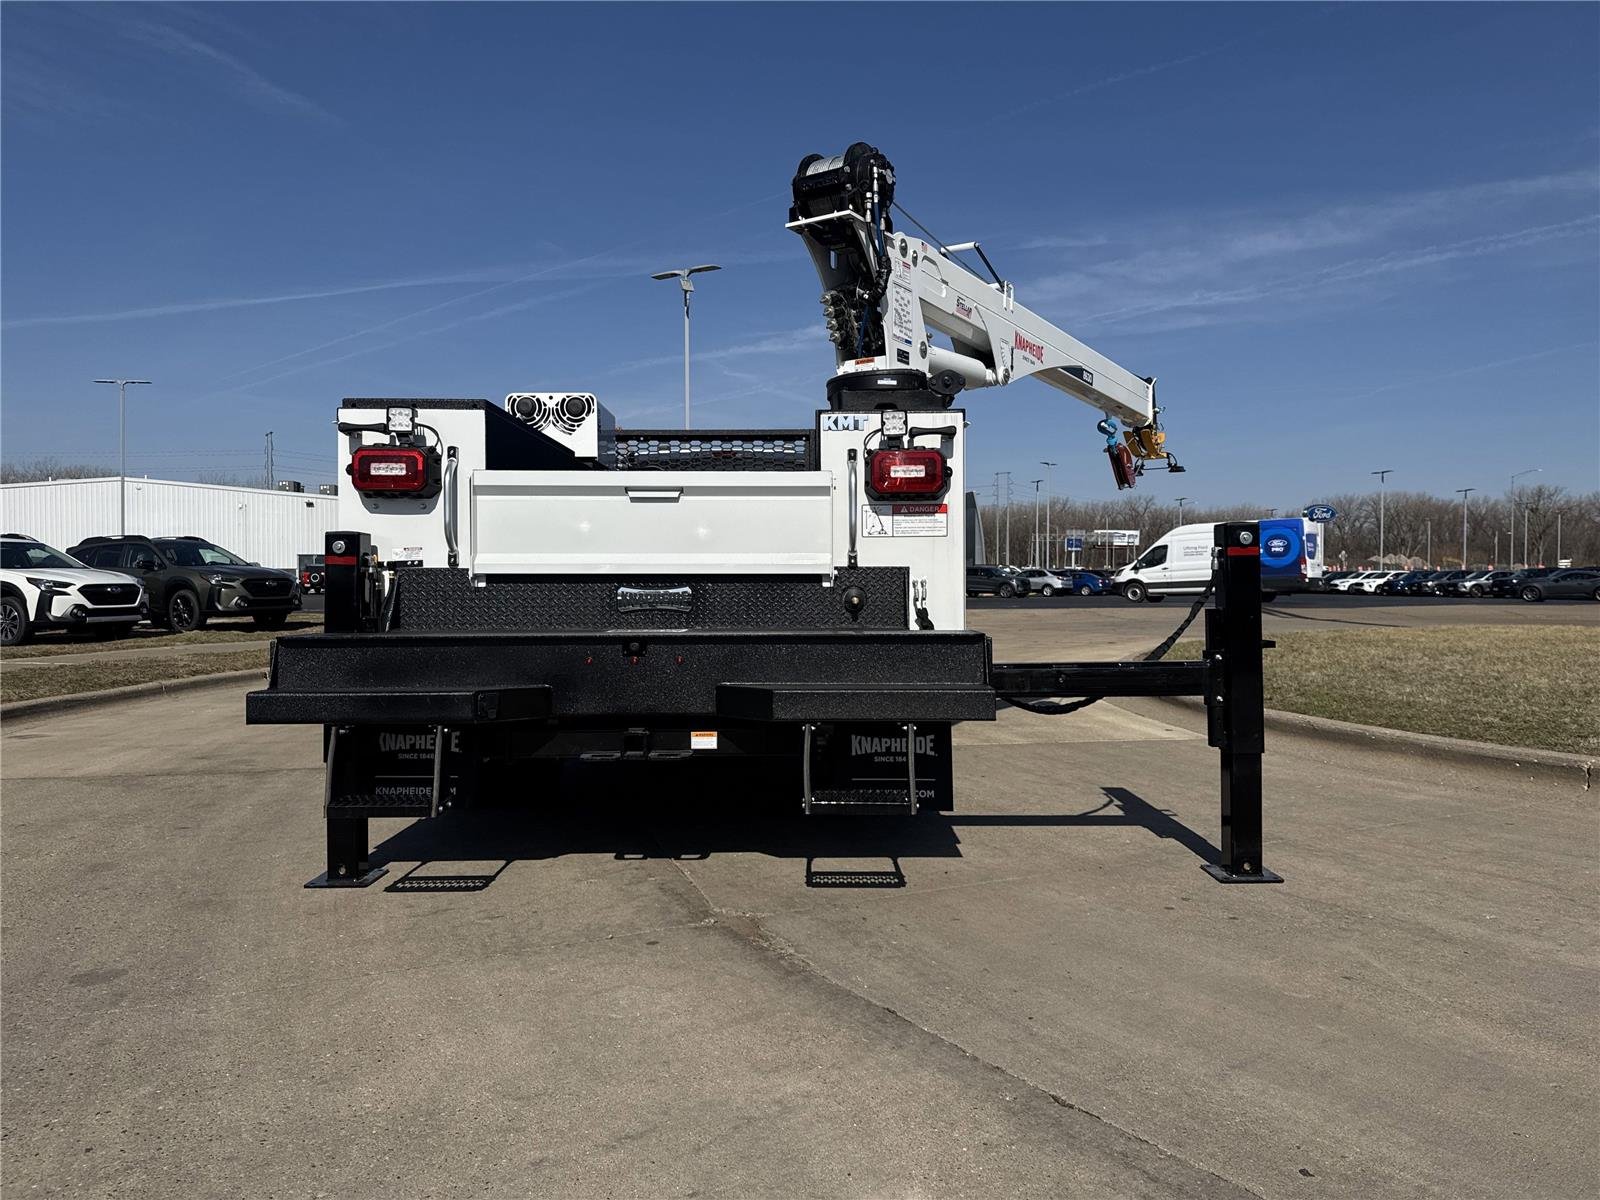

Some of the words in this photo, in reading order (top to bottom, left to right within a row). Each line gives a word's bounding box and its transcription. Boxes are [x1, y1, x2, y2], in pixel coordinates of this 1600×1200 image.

[1014, 330, 1044, 364] KNAPHEIDE
[822, 414, 868, 431] KMT
[909, 505, 939, 513] DANGER
[1312, 508, 1332, 519] Ford
